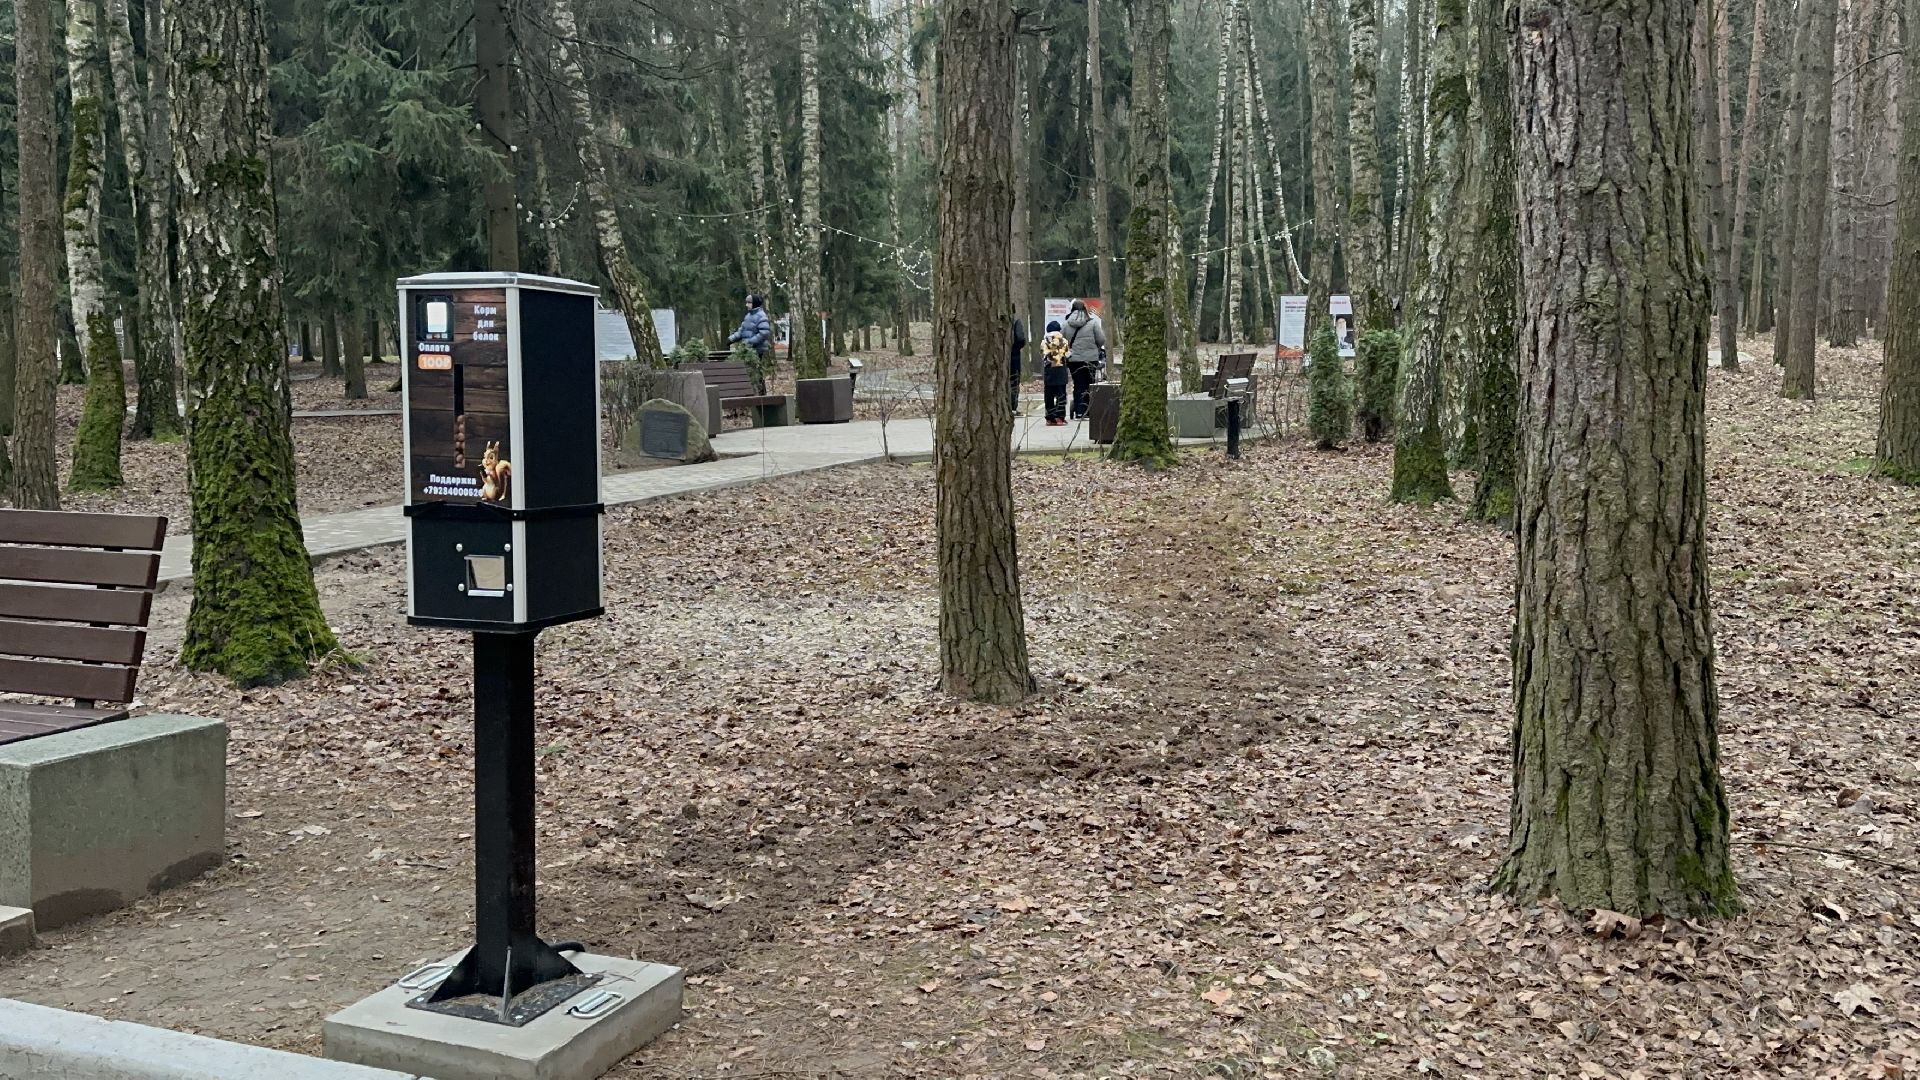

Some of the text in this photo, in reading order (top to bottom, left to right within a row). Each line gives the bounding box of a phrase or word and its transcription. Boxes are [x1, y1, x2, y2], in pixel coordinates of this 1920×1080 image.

[474, 305, 497, 316] Корм
[477, 320, 494, 328] для
[472, 331, 499, 341] белок
[418, 343, 450, 352] Оплата
[429, 474, 477, 486] Поддержка
